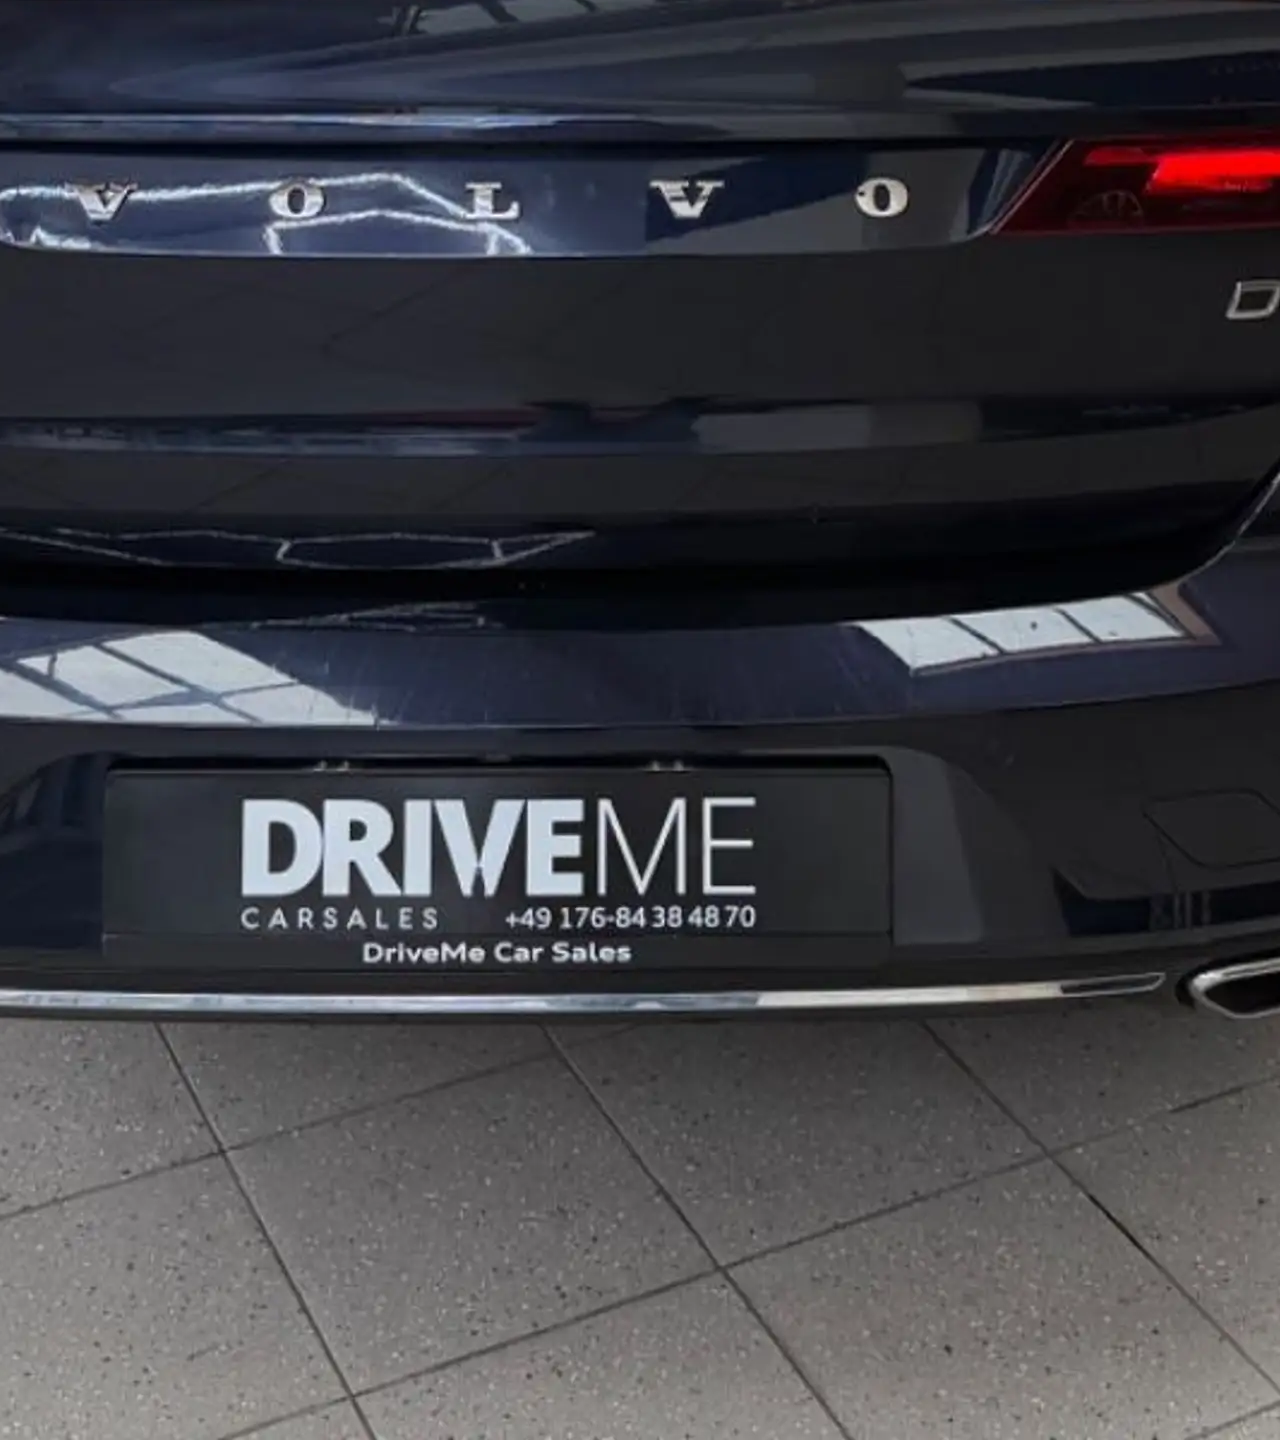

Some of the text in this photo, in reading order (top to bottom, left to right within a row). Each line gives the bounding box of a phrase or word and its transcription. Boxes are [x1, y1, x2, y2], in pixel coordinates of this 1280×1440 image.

[64, 175, 909, 220] VOLVO
[240, 796, 756, 898] DRIVEME
[240, 906, 438, 930] CARSALES
[505, 906, 552, 929] +49
[362, 940, 632, 963] DriveMe Car Sales
